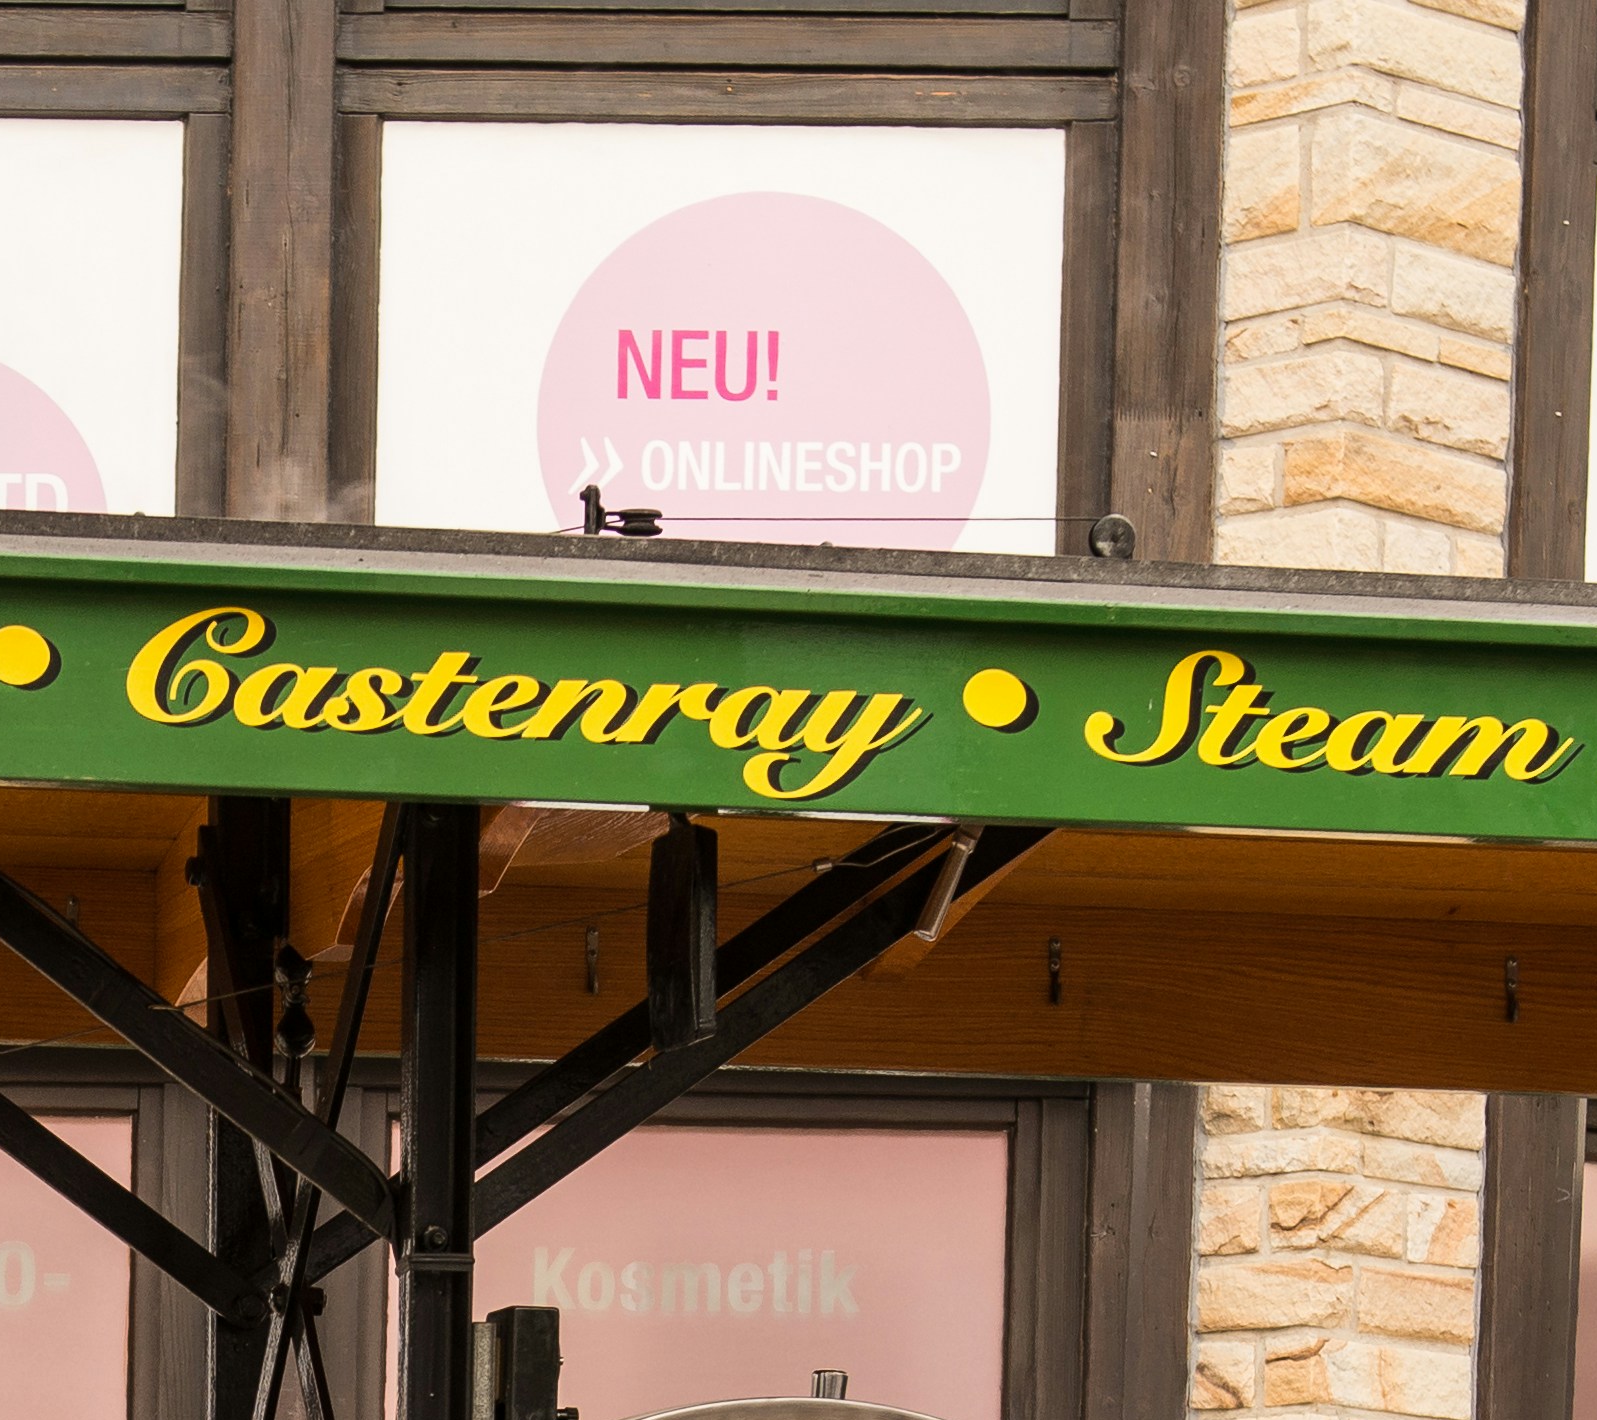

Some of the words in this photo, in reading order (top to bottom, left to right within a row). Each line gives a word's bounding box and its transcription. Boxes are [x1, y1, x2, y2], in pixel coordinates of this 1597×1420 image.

[616, 329, 780, 402] NEU!
[640, 440, 962, 493] ONLINESHOP
[125, 606, 923, 800] Castenray
[1085, 649, 1574, 784] Steam
[532, 1245, 860, 1318] Kosmetik
